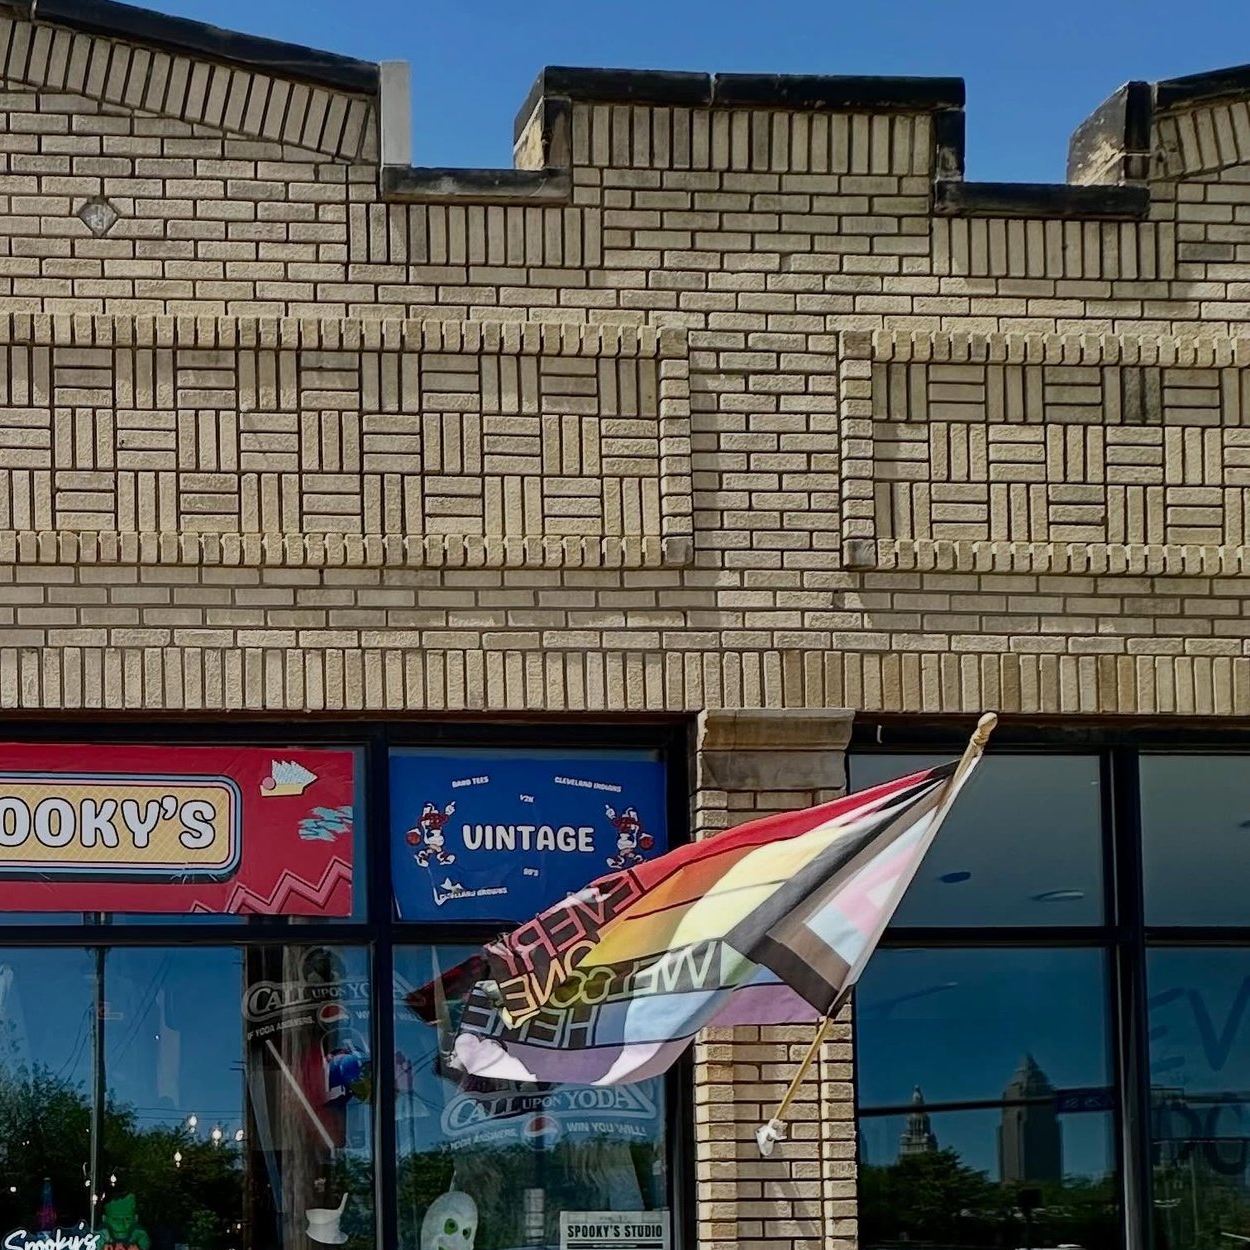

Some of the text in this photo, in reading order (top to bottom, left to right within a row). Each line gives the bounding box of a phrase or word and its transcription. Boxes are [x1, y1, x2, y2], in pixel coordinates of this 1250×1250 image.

[462, 824, 595, 852] VINTAGE
[450, 1087, 638, 1127] CALL UPON YODA
[567, 1225, 663, 1238] SPOOKY'S STUDIO
